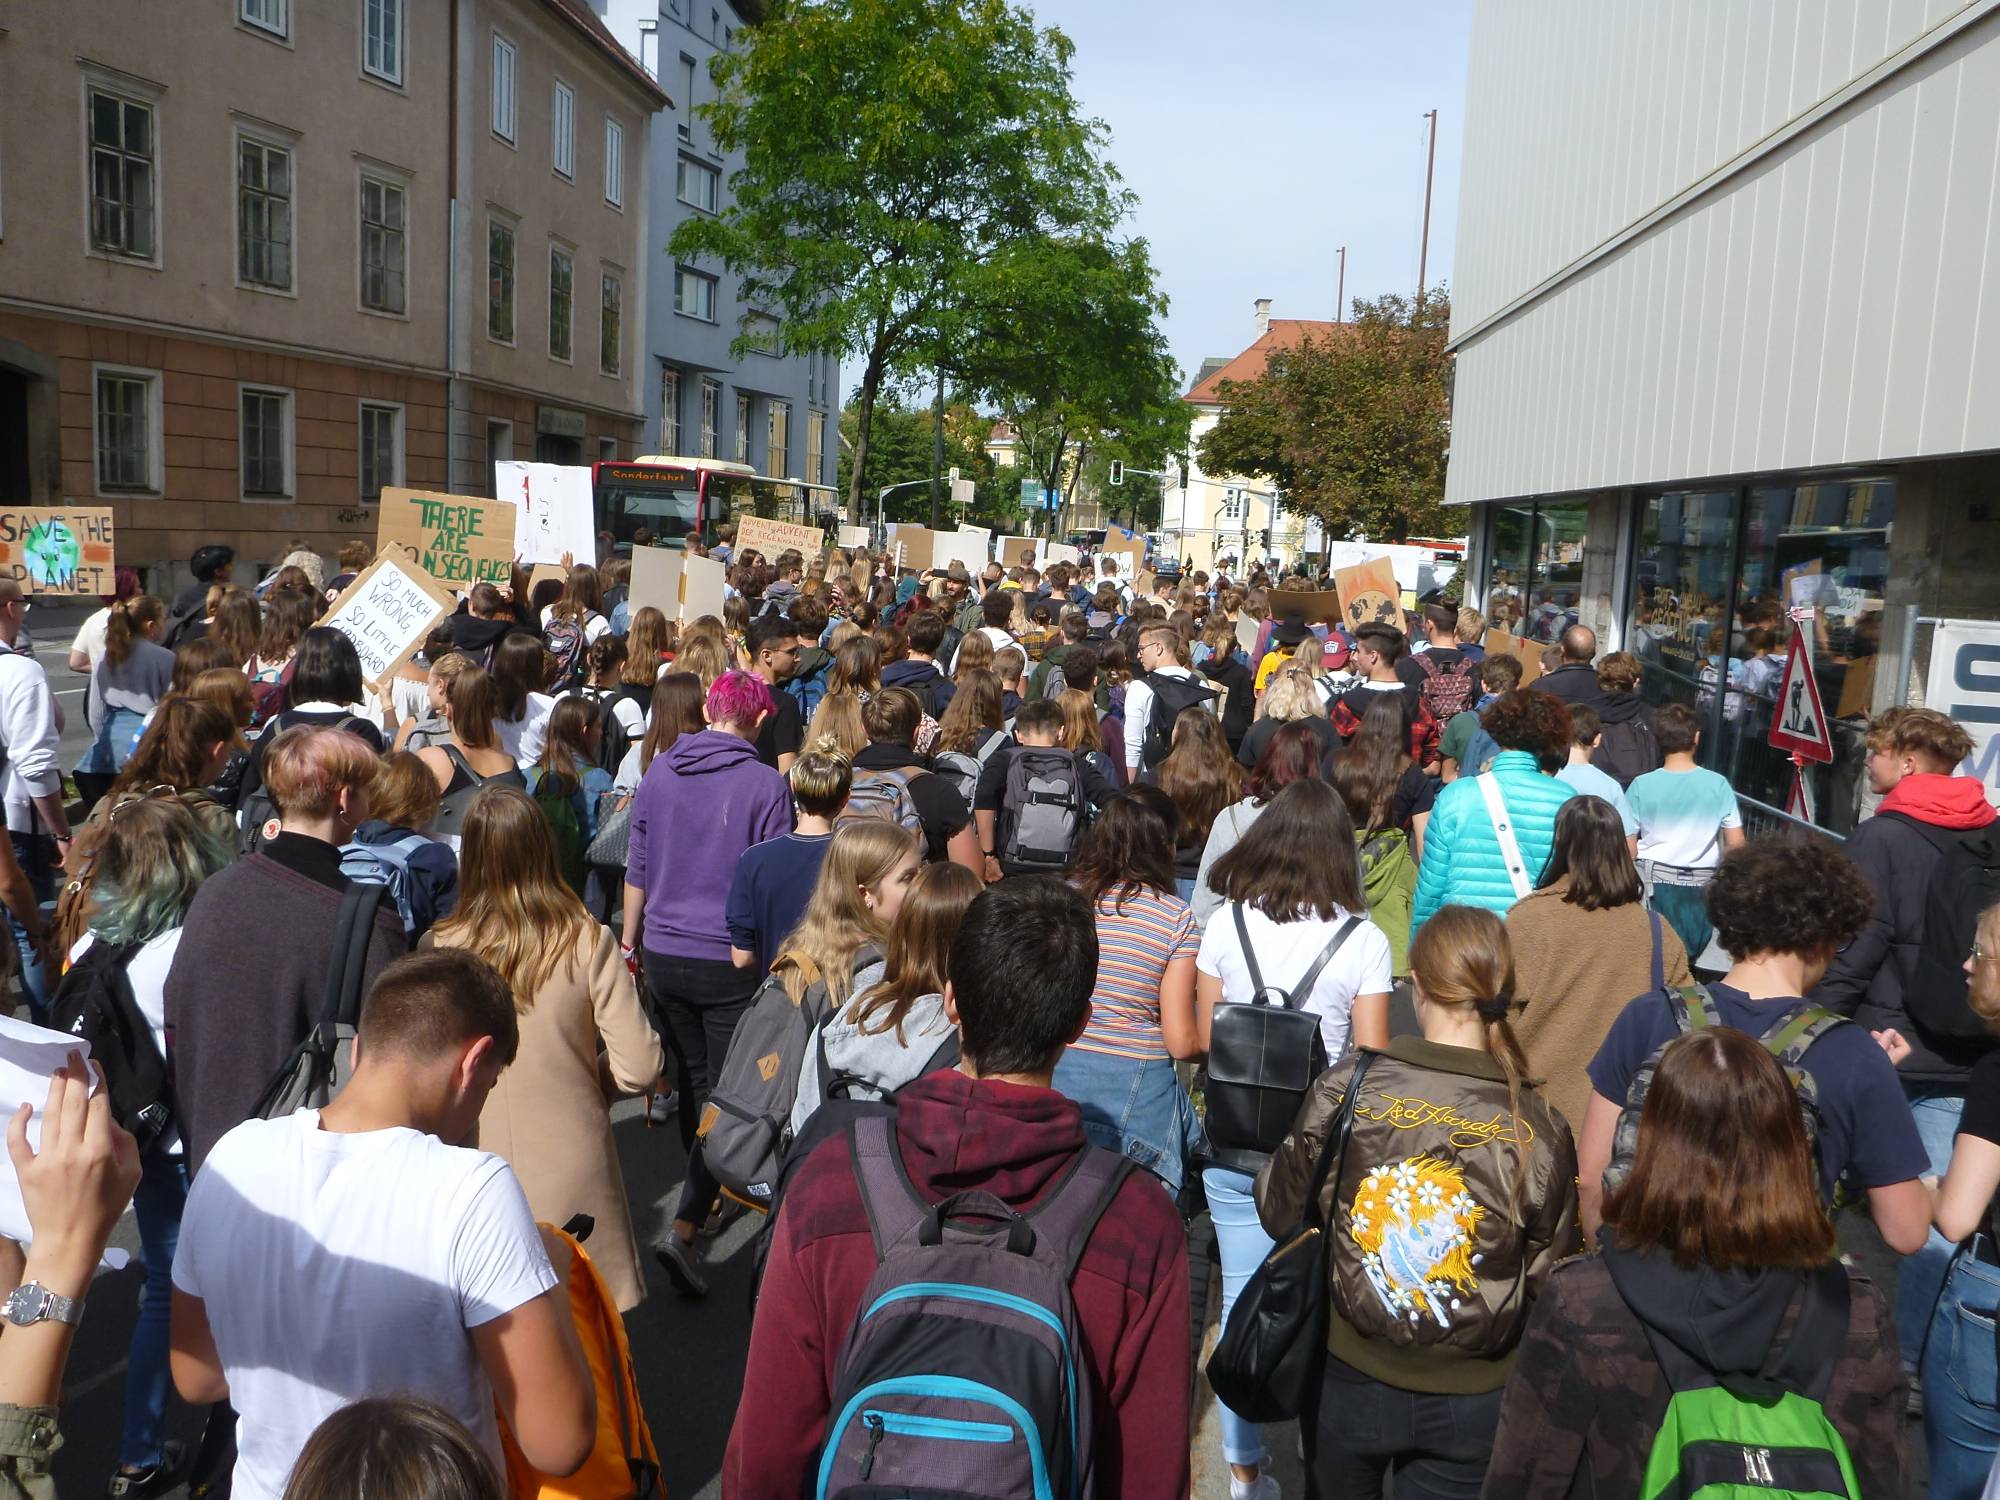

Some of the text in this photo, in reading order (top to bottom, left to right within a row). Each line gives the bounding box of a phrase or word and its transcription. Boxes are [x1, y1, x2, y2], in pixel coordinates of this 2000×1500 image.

[612, 470, 684, 481] Sonderfahrt
[0, 513, 112, 544] SAVE THE
[409, 498, 484, 536] THERE
[430, 528, 469, 554] ARE
[12, 564, 103, 594] PLANET
[381, 570, 433, 619] SO MUCH
[368, 583, 416, 635] WRONG,
[346, 605, 401, 657] SO LITTLE
